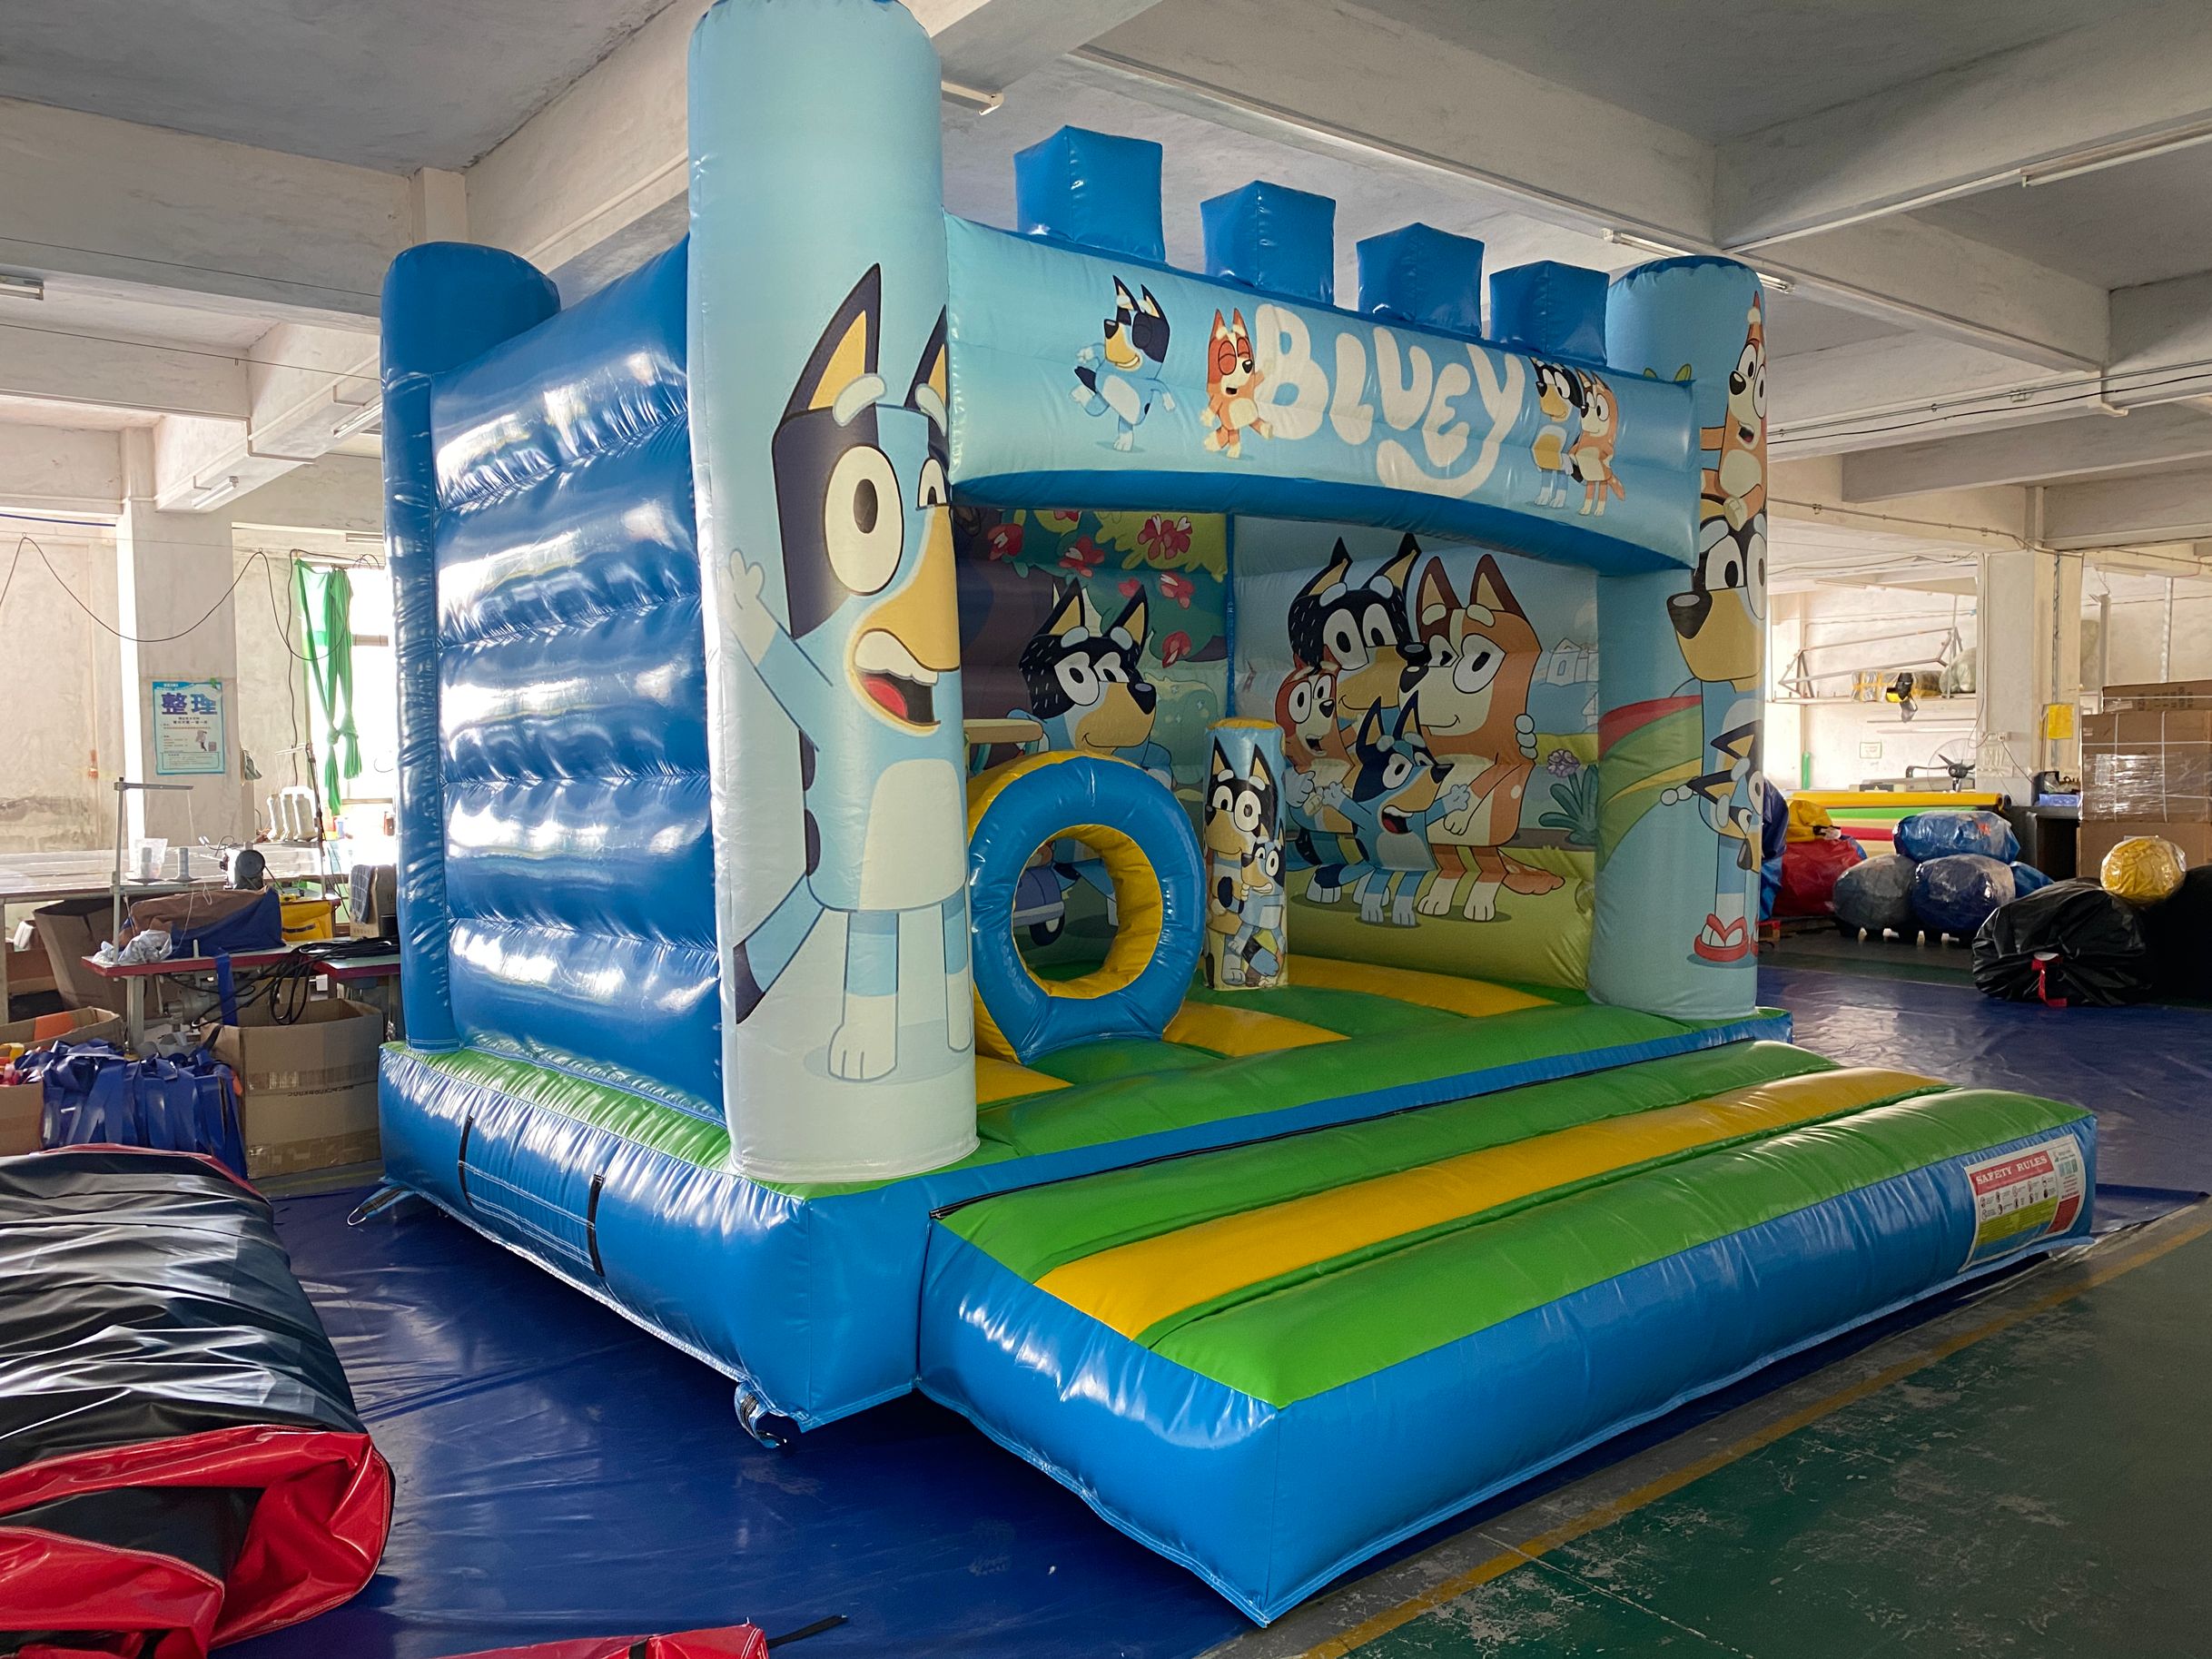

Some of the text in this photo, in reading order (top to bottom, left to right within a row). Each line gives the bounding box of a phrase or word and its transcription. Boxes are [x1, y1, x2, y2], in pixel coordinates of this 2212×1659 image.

[162, 693, 218, 715] 整理
[1976, 1155, 2048, 1184] SAFETY RULES
